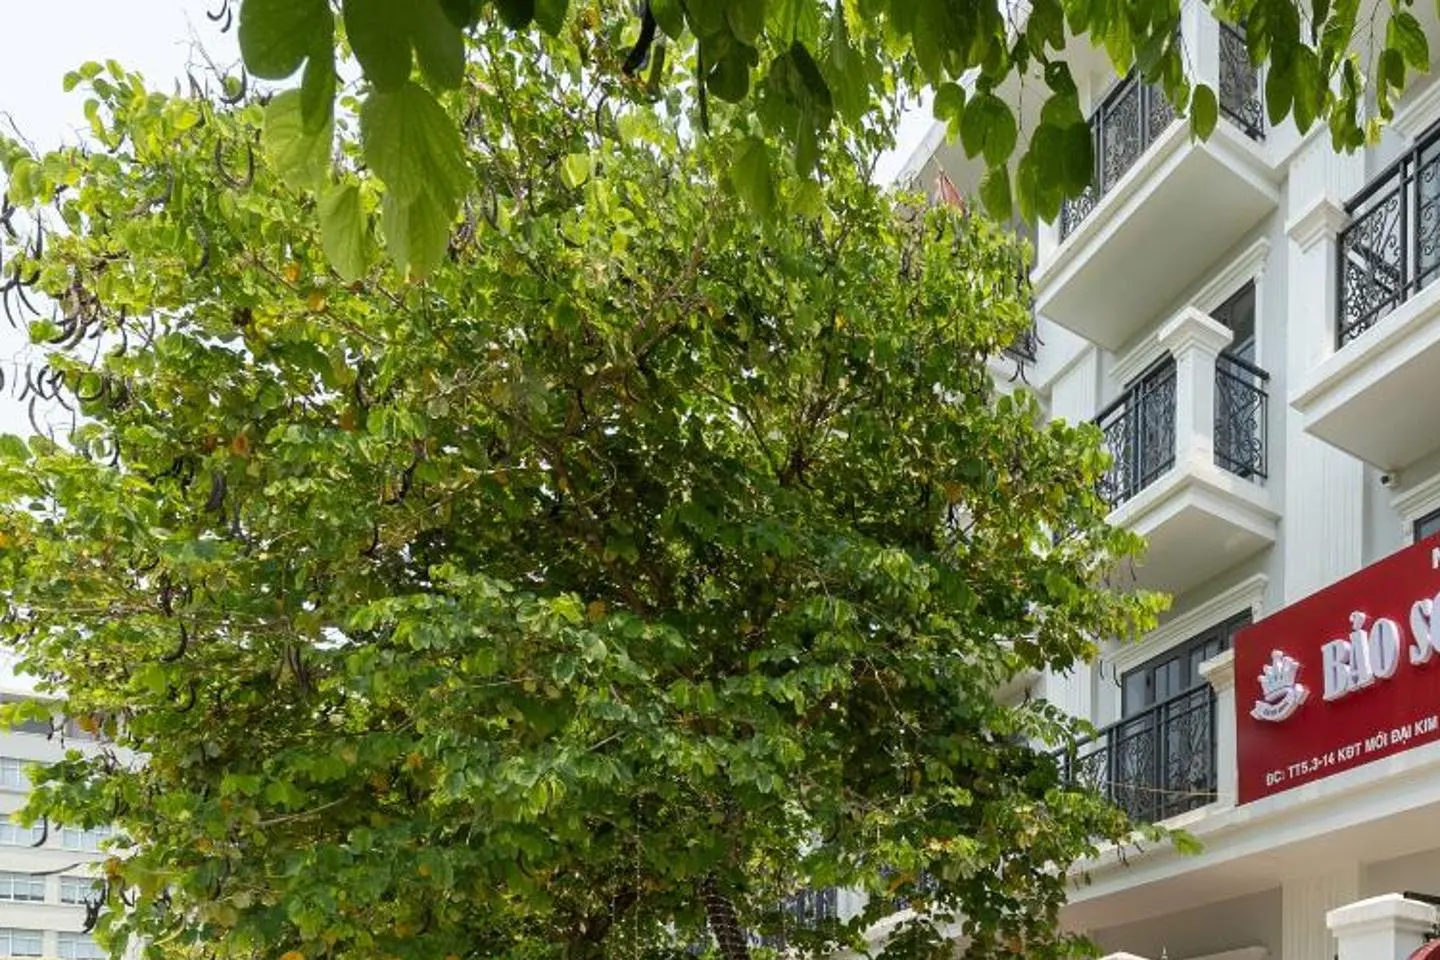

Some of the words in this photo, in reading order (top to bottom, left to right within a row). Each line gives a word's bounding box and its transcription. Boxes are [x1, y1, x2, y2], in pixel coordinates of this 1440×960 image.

[1320, 610, 1401, 701] BẢO
[1288, 752, 1335, 779] TT5.3-14
[1337, 742, 1362, 764] KĐT
[1365, 731, 1388, 753] MỚI
[1391, 727, 1412, 745] ĐẠI
[1414, 715, 1439, 736] KIM
